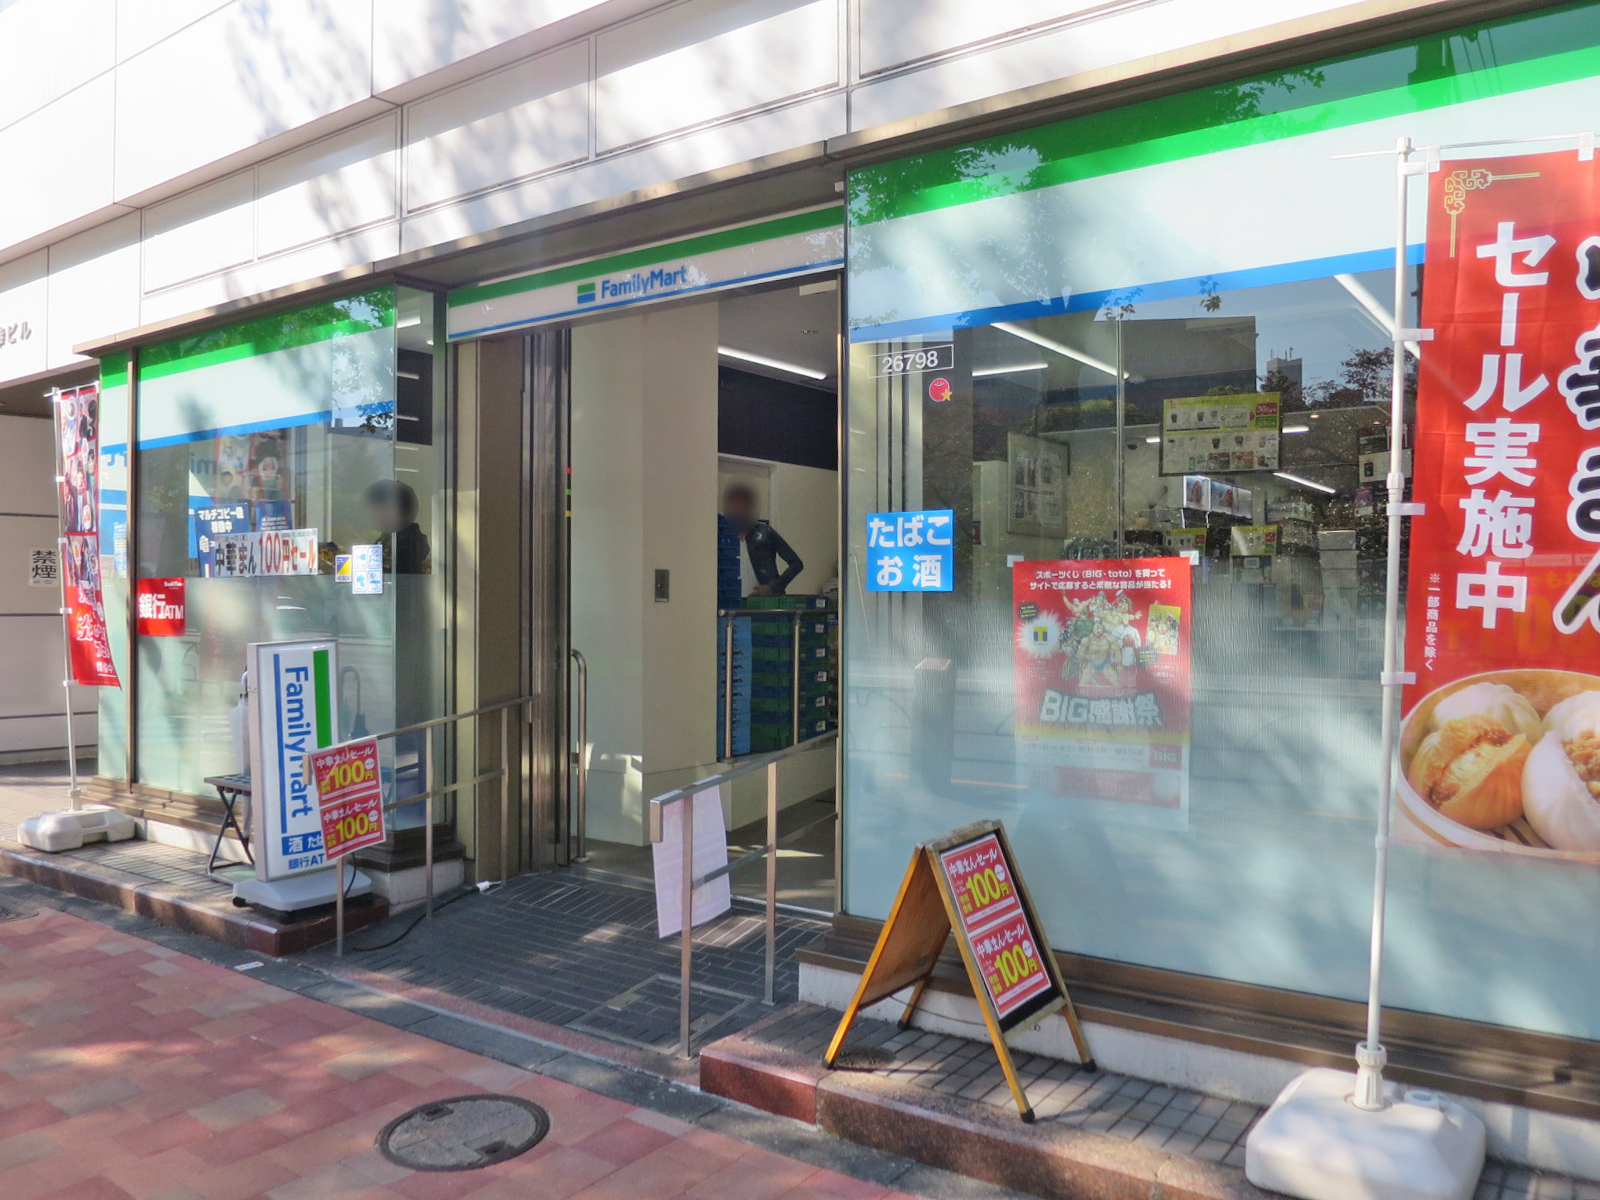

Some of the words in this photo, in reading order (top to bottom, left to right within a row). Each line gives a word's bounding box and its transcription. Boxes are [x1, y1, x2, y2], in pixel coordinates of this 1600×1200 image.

[601, 265, 687, 299] FamilyMart
[882, 351, 938, 373] 26798
[1455, 222, 1557, 629] セール実施中
[869, 514, 951, 548] たばこ
[32, 550, 57, 579] 禁煙
[876, 555, 942, 588] お酒
[138, 593, 184, 620] 銀行ATM
[288, 836, 303, 853] 酒
[949, 848, 998, 878] 中華まんセール
[976, 923, 1025, 959] 中華まんセール
